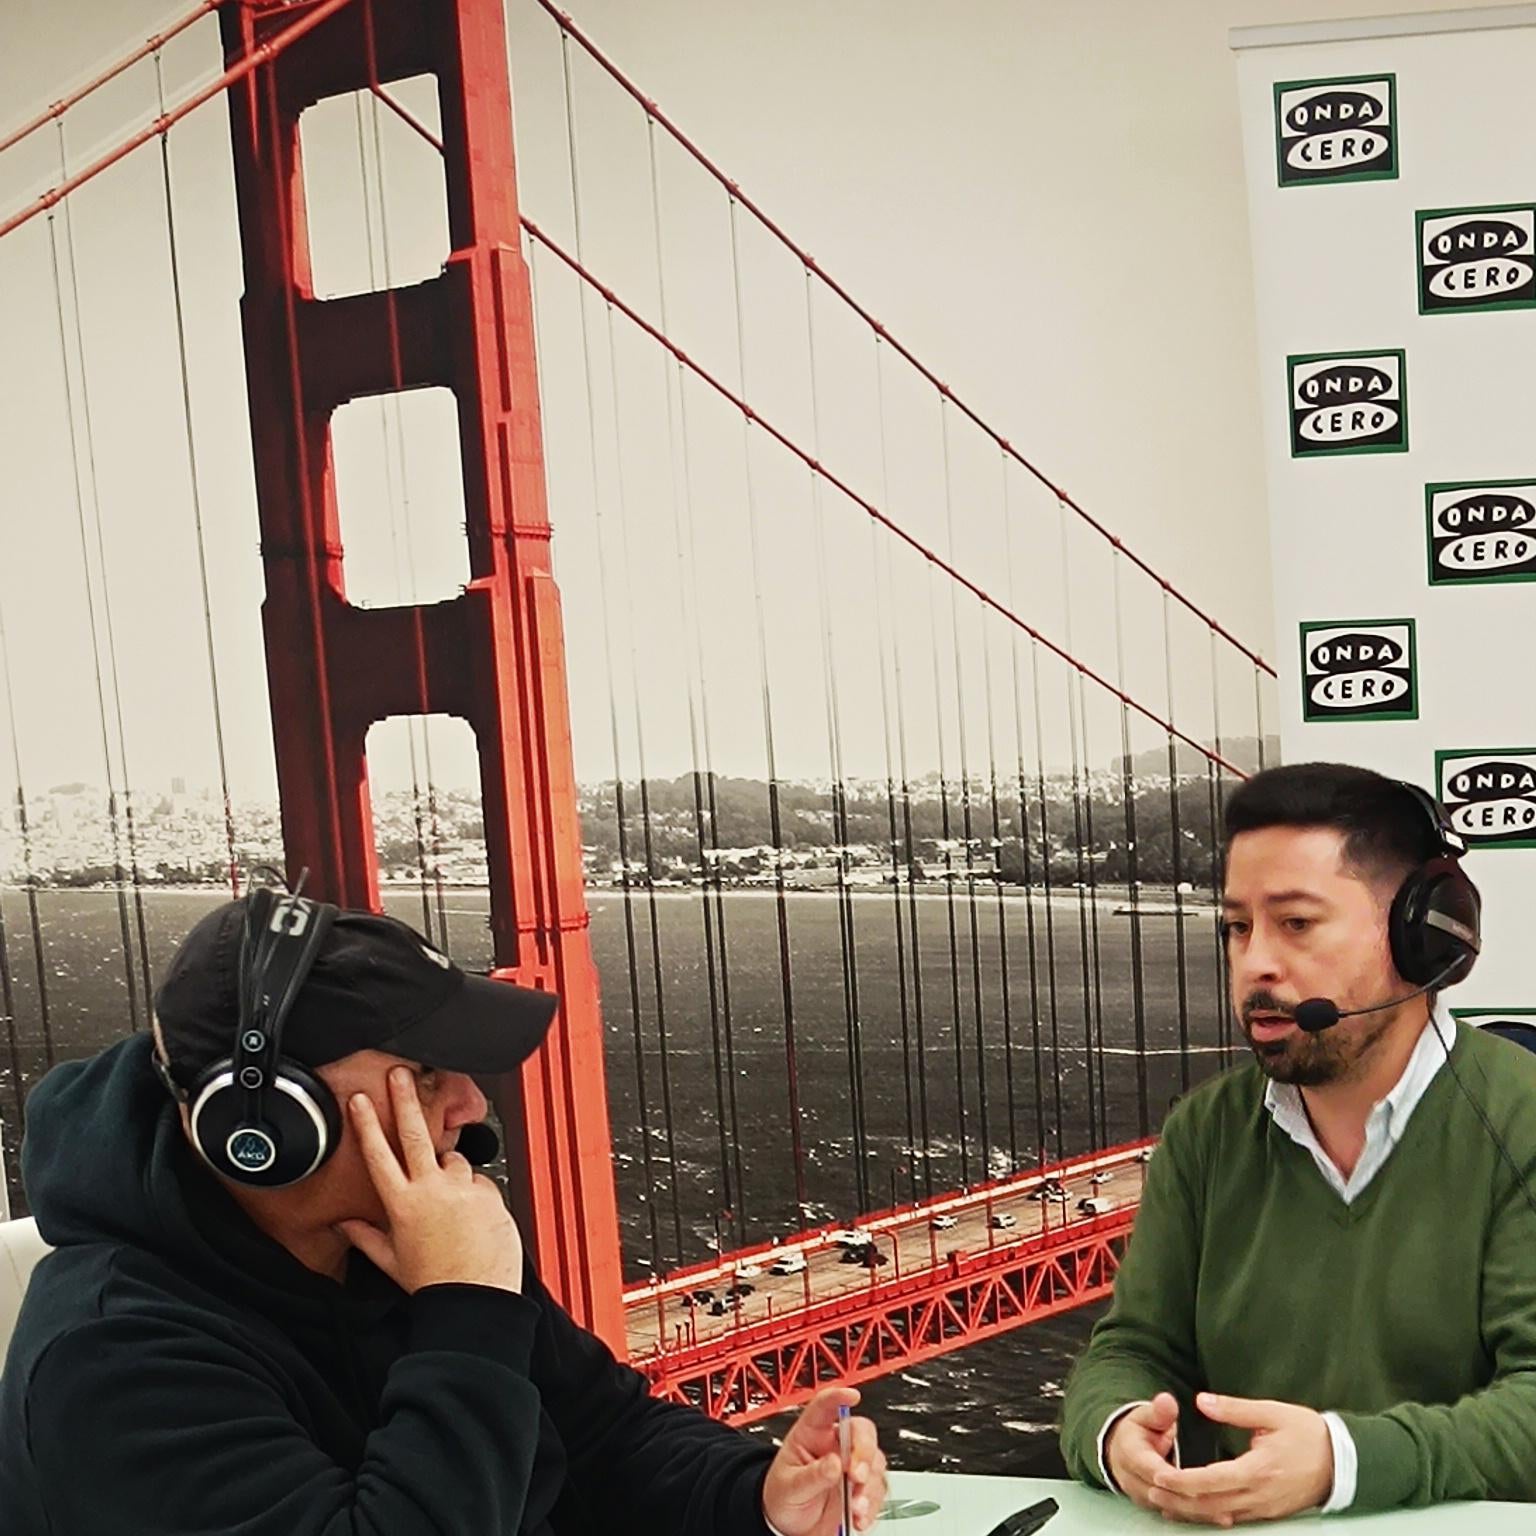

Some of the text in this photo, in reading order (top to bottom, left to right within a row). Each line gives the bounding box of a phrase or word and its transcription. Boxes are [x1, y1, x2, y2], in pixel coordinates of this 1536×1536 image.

[1294, 101, 1374, 126] ONDA
[1300, 137, 1375, 163] CERO
[1437, 230, 1519, 254] ONDA
[1443, 266, 1520, 291] CERO
[1306, 375, 1384, 398] ONDA
[1312, 410, 1385, 434] CERO
[1447, 504, 1527, 527] ONDA
[1452, 539, 1528, 563] CERO
[1317, 644, 1394, 665] ONDA
[1323, 678, 1395, 700] CERO
[1456, 772, 1535, 793] ONDA
[1462, 806, 1536, 828] CERO
